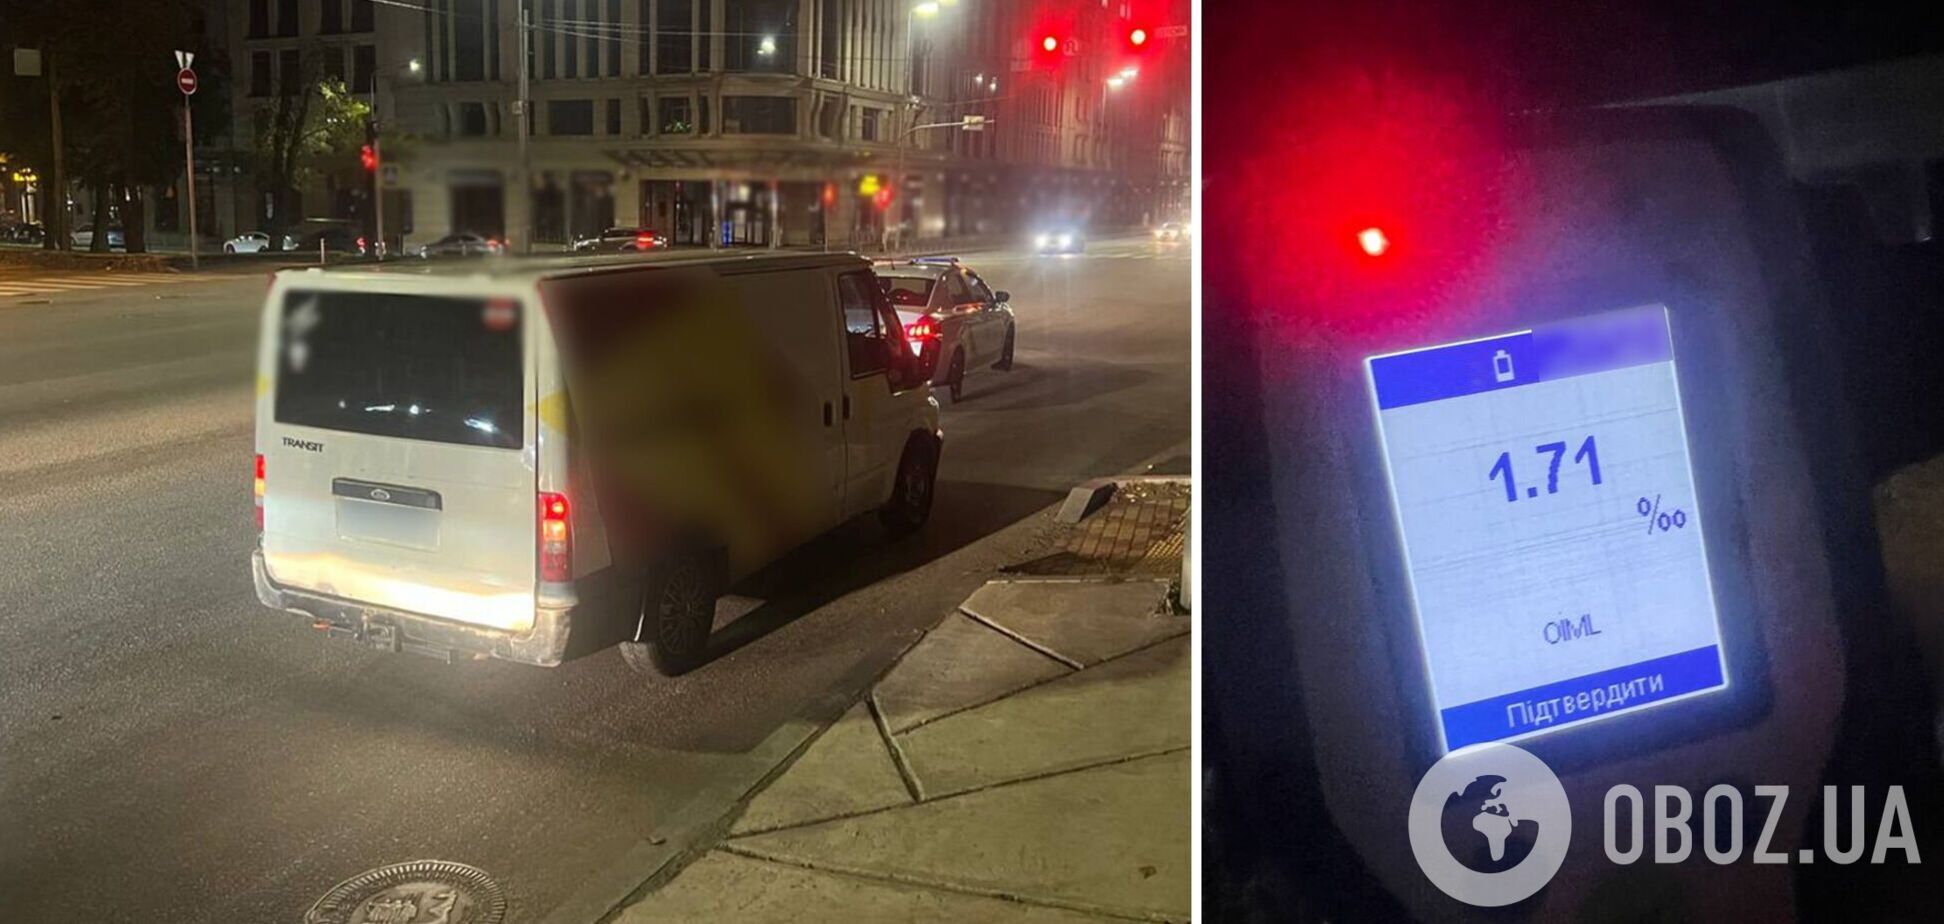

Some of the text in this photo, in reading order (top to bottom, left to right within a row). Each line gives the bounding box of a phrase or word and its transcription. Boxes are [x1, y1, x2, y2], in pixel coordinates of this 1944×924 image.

[282, 437, 324, 453] TRANSIT
[1489, 436, 1602, 502] 1.71
[1543, 614, 1602, 645] OIML
[1506, 674, 1665, 729] Підтвердити
